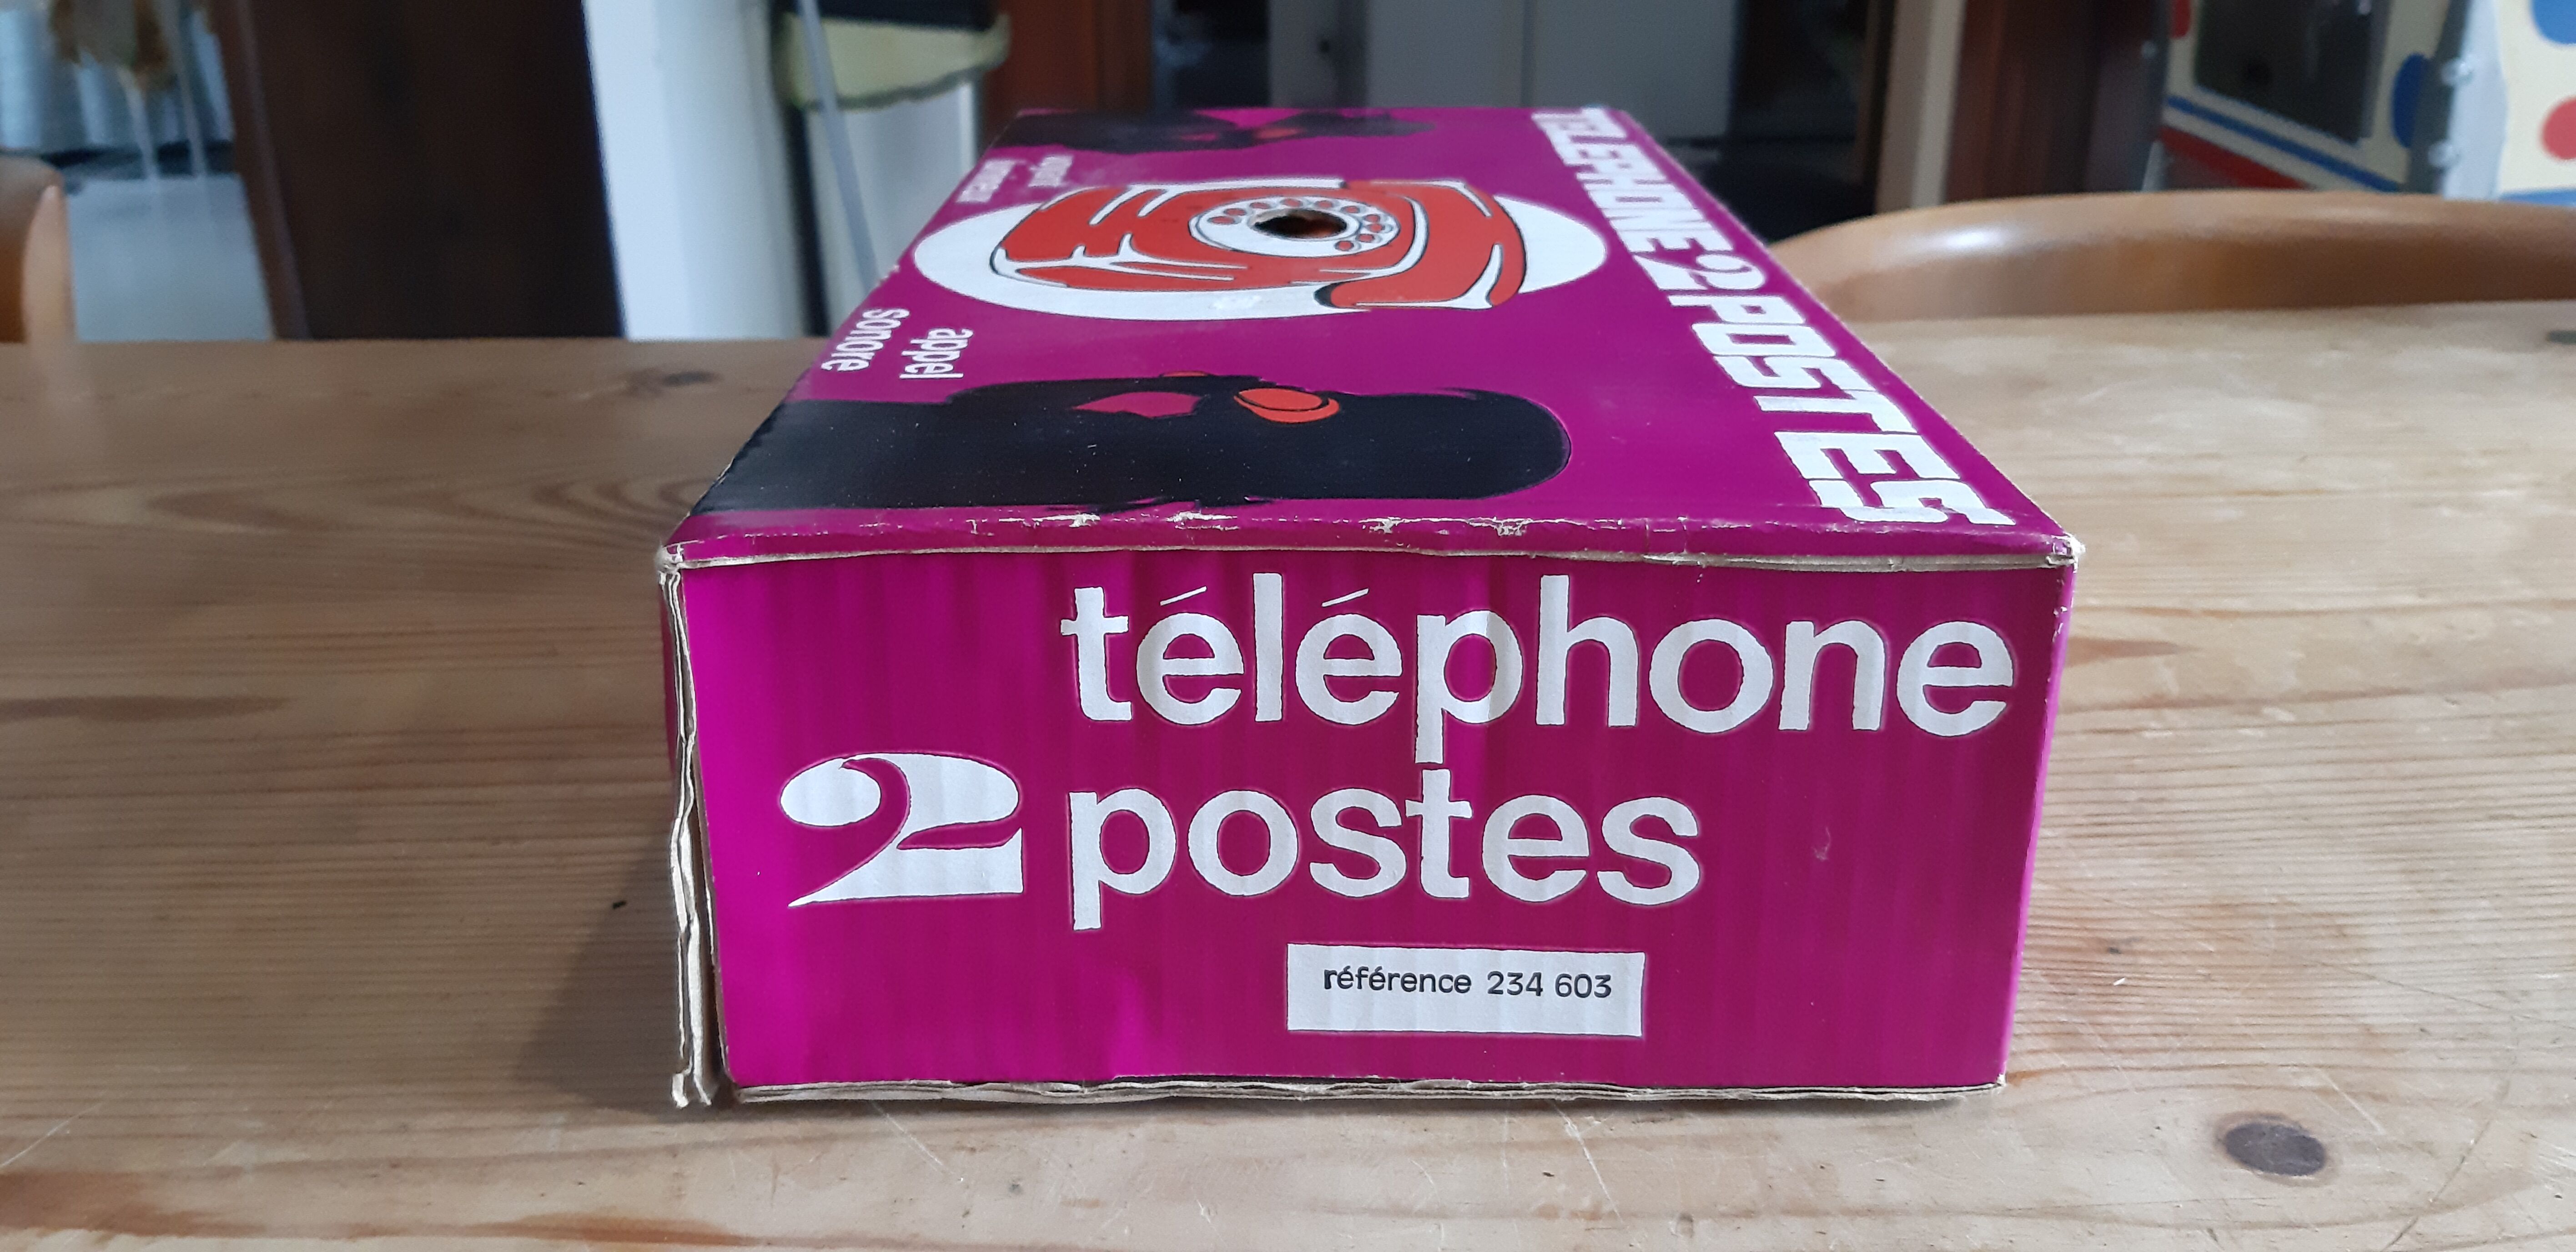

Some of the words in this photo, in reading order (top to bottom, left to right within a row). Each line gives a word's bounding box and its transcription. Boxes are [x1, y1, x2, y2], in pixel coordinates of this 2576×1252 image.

[1634, 253, 1766, 291] 2
[820, 308, 911, 372] sonore
[899, 328, 974, 379] appel
[1667, 293, 2016, 525] POSTES
[1059, 572, 2014, 765] téléphone
[779, 752, 1024, 909] 2
[1069, 768, 1701, 932] postes
[1323, 965, 1472, 994] référence
[1487, 971, 1544, 996] 234
[1555, 974, 1612, 998] 603
